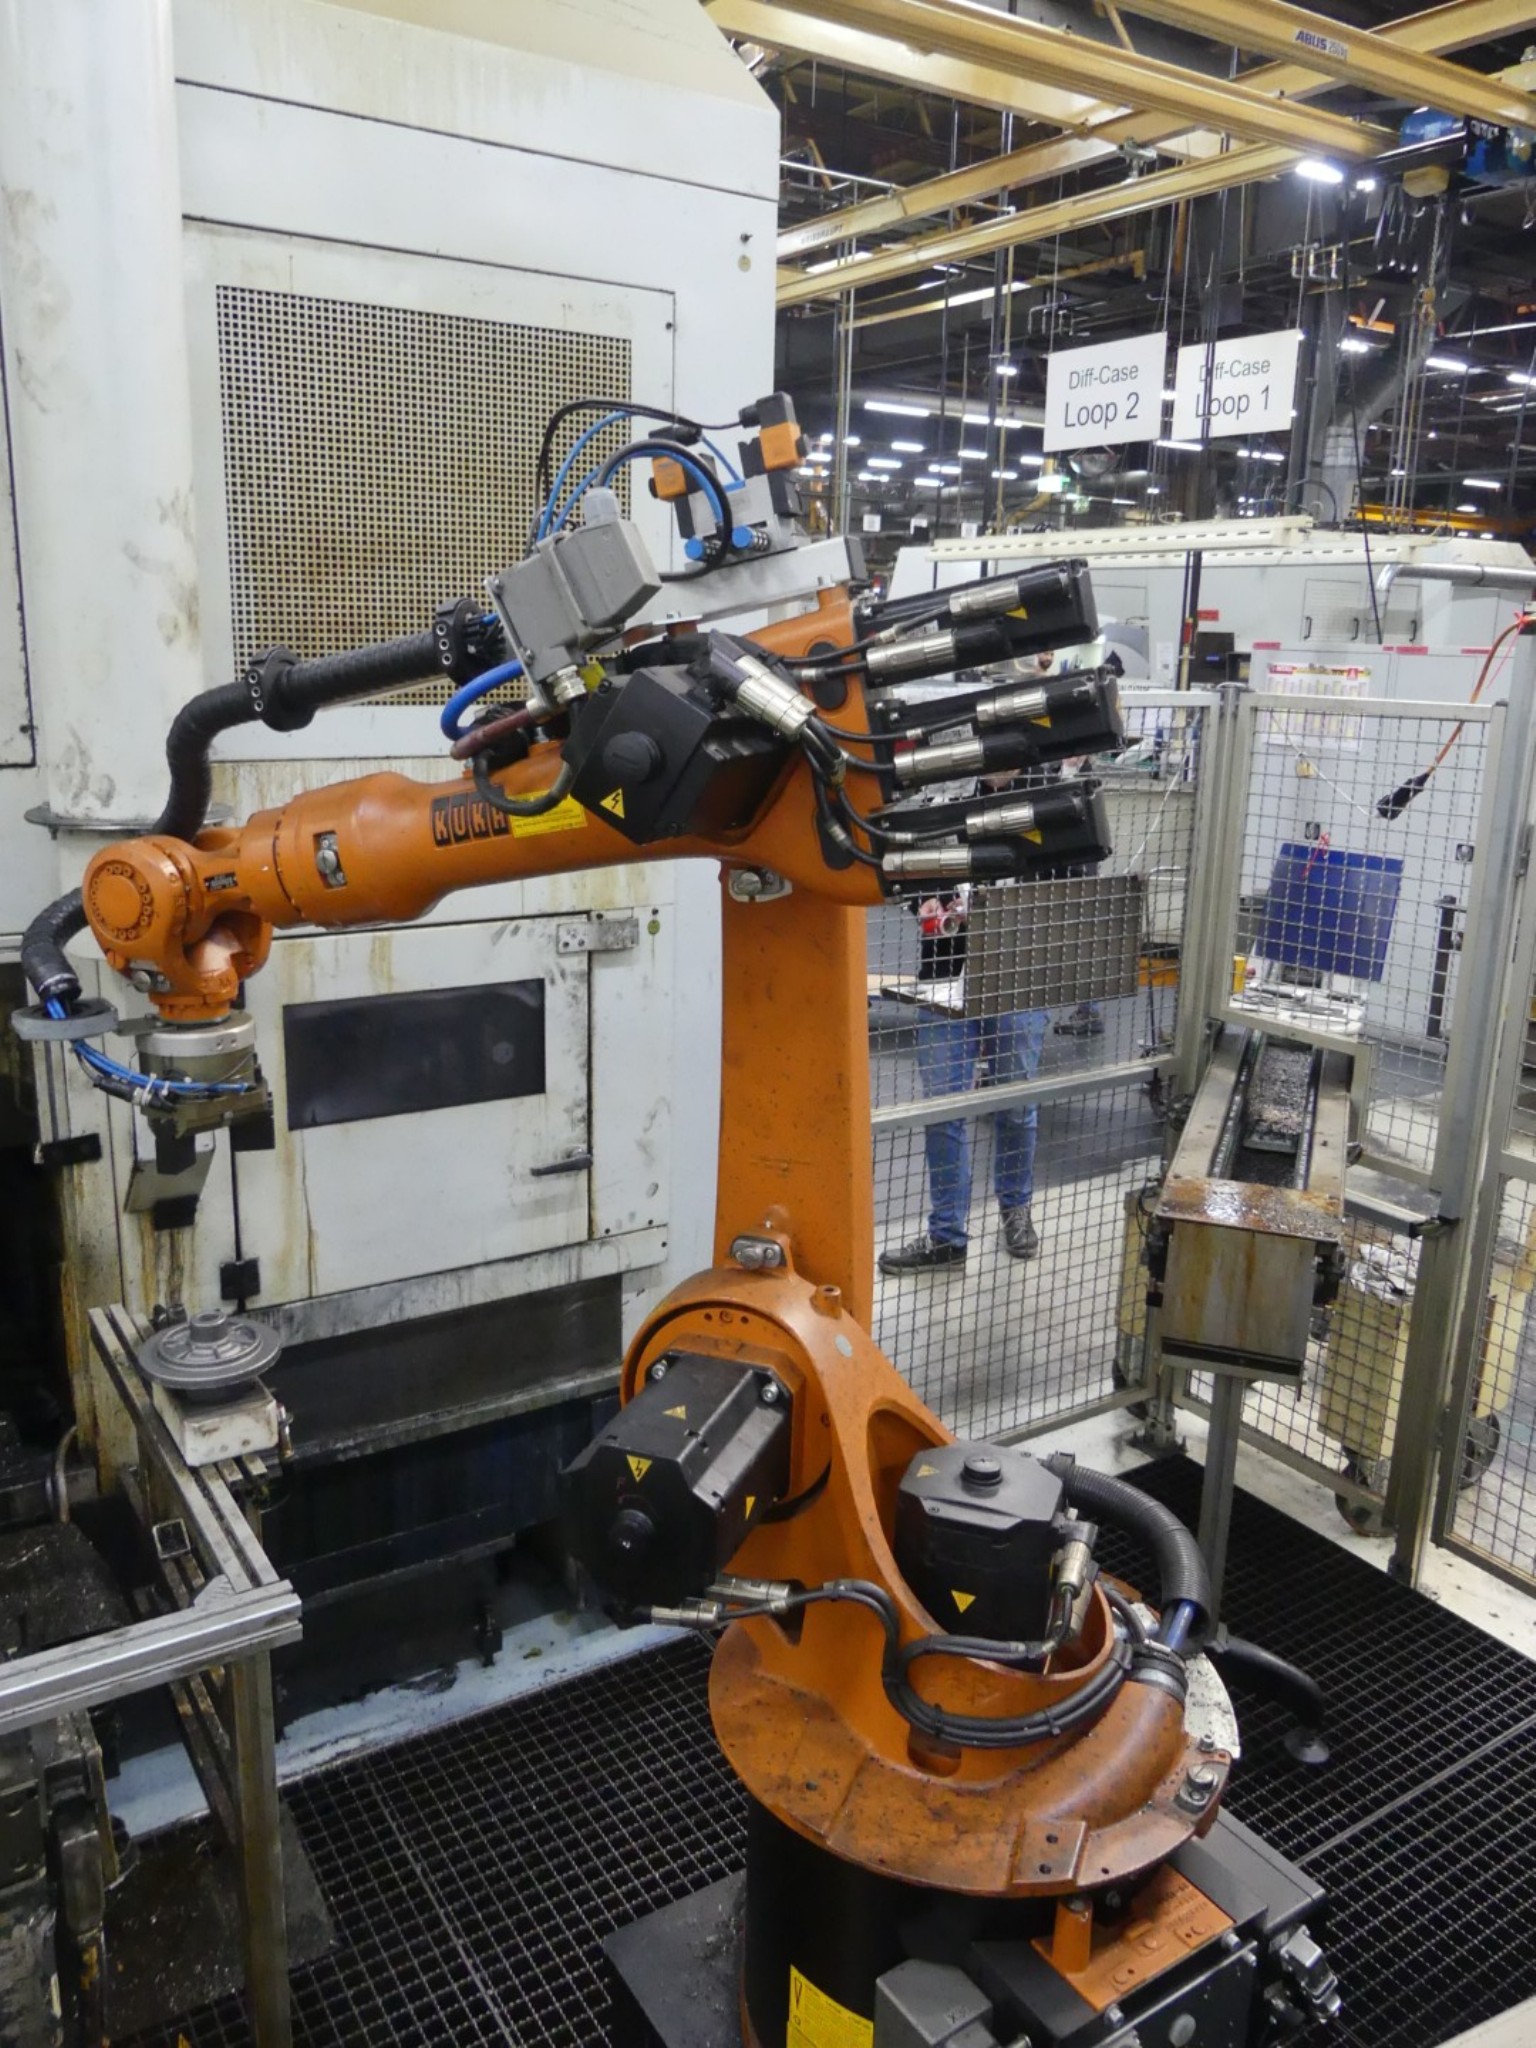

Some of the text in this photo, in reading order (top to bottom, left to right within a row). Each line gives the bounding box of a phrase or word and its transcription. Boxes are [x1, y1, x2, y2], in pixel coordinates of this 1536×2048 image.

[1295, 30, 1328, 51] ABUS
[1069, 364, 1139, 390] Diff-Case
[1199, 359, 1271, 383] Dff-Case
[1064, 391, 1140, 430] Loop 2
[1195, 385, 1270, 420] Loop 1
[434, 800, 508, 841] KUKA
